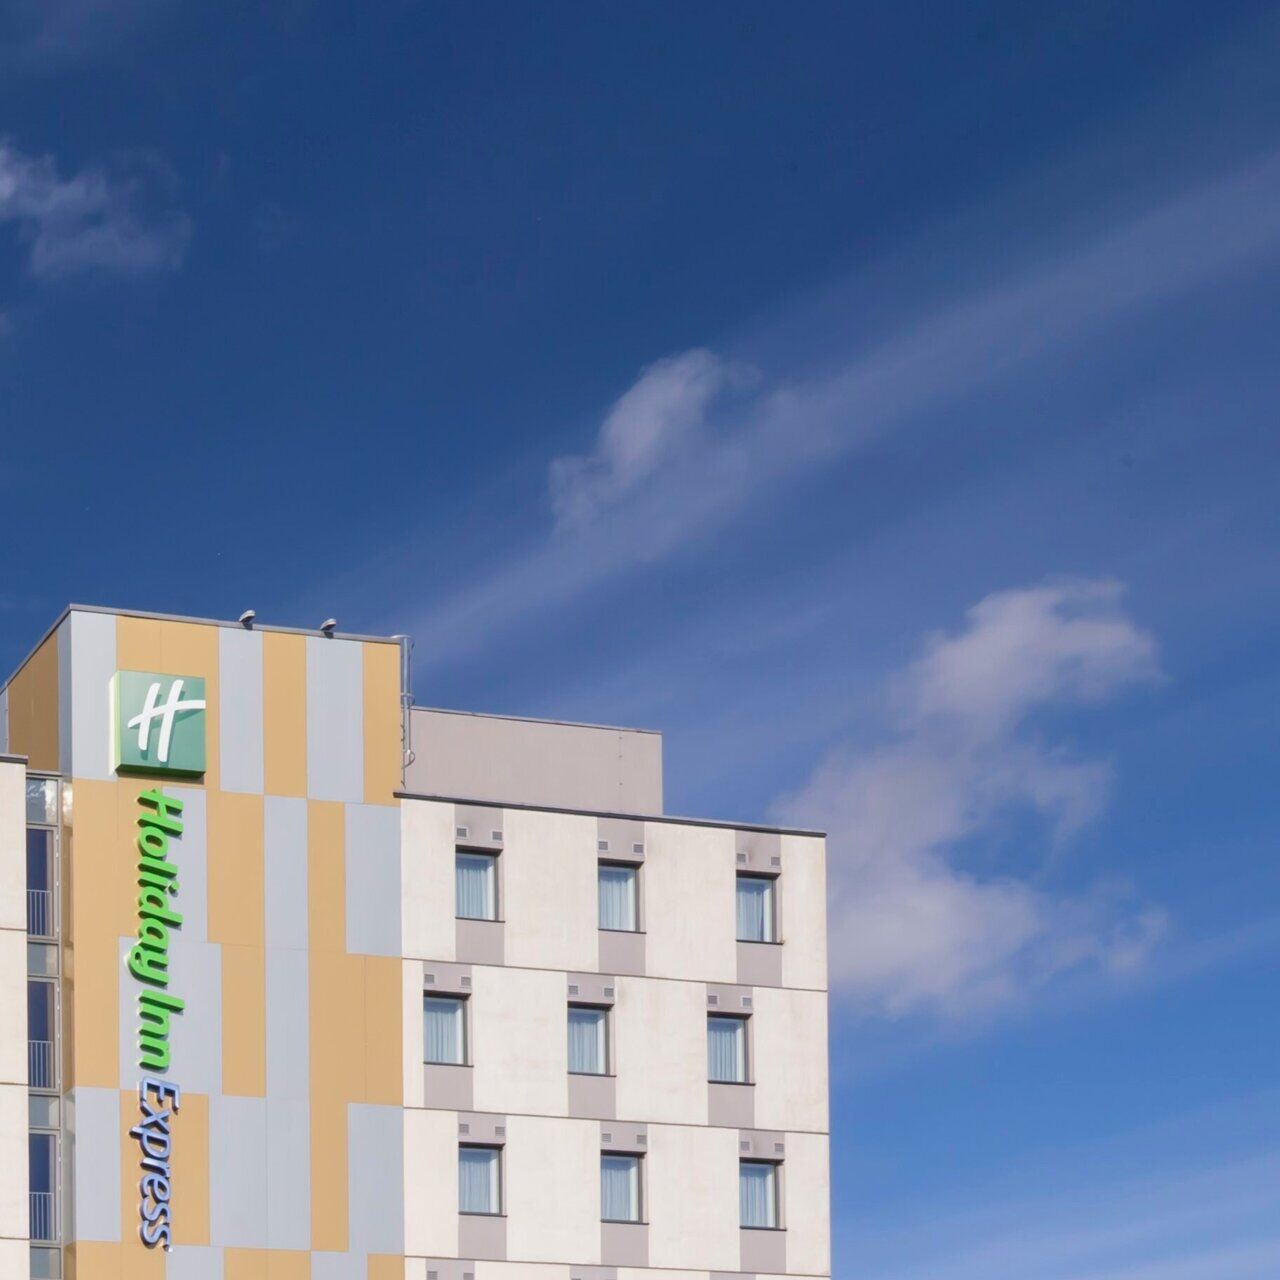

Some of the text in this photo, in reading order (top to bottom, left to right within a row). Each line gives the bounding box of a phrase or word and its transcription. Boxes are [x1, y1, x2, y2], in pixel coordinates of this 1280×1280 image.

[129, 790, 184, 1250] Holiday Inn Express
